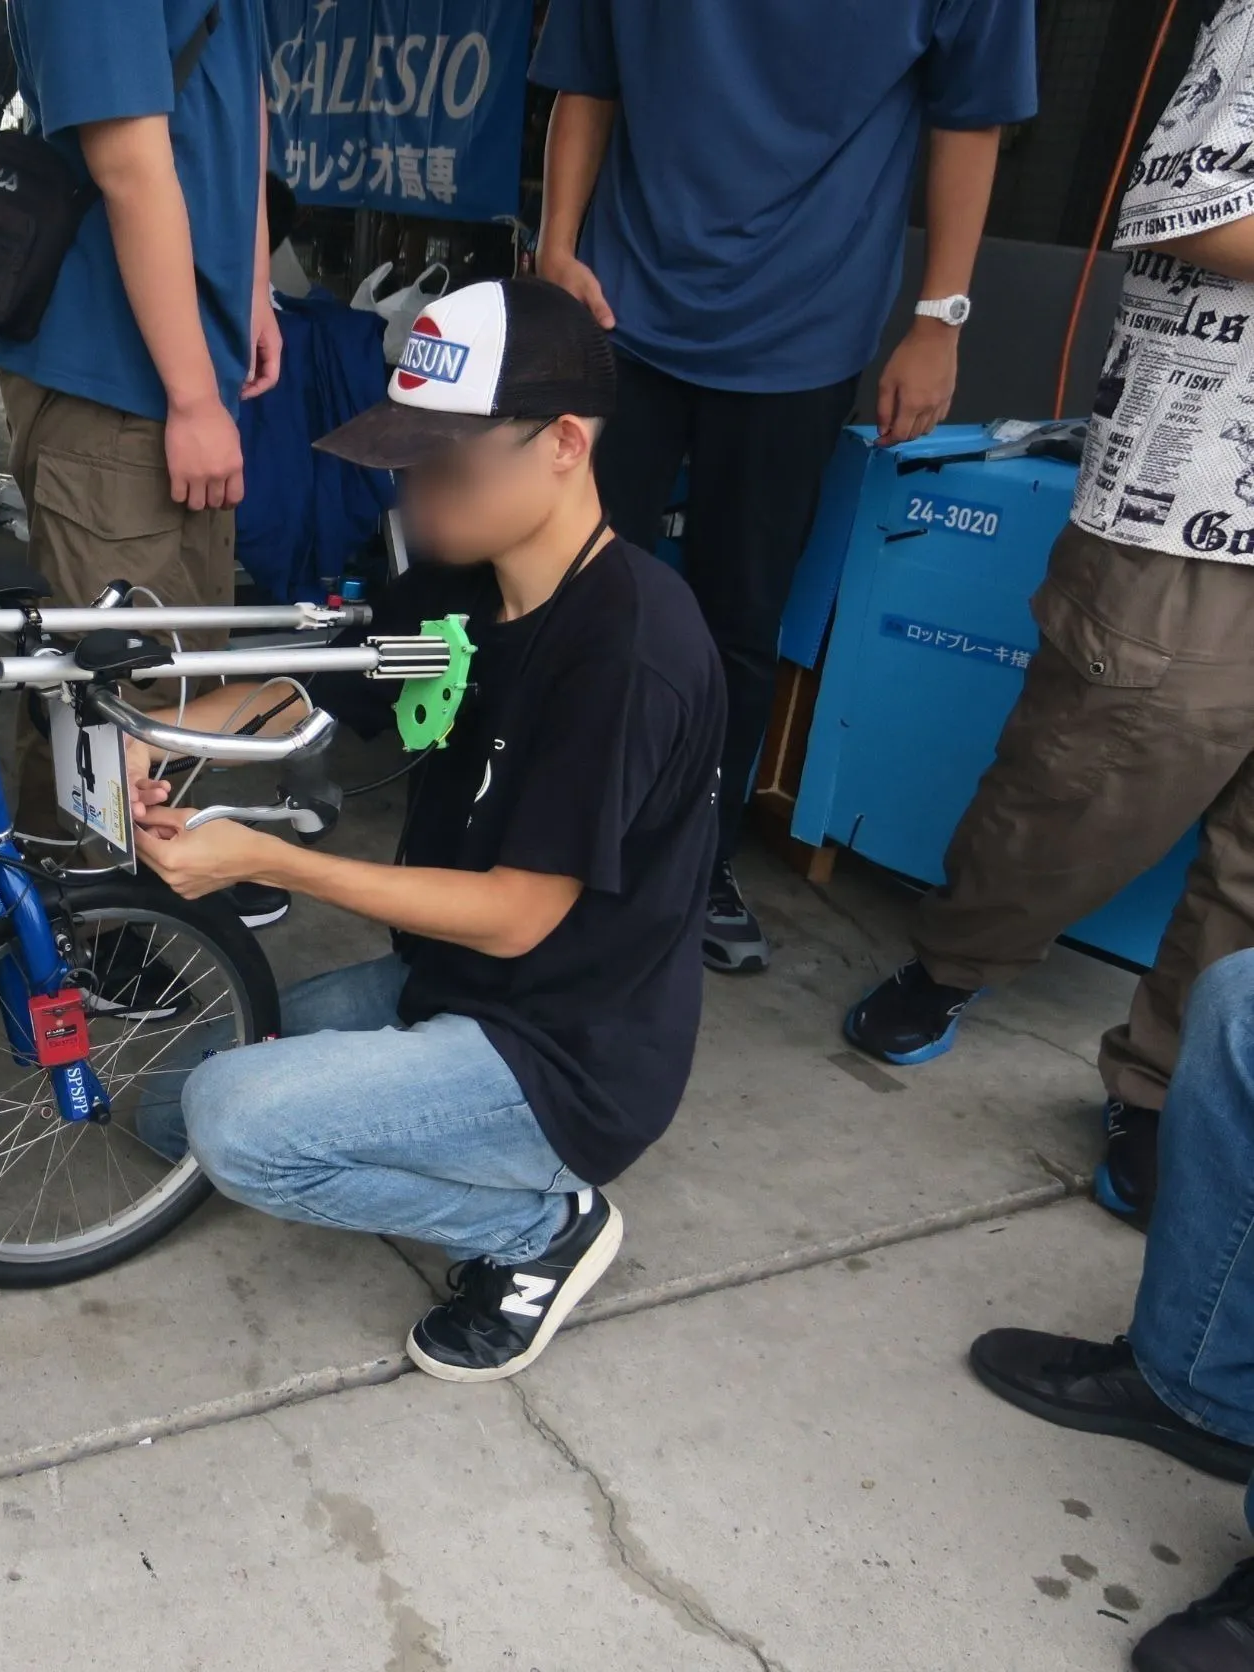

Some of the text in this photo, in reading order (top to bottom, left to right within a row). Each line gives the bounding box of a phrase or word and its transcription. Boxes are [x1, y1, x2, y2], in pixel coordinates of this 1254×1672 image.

[267, 28, 491, 120] SALESIO
[284, 138, 458, 204] サレジオ高専
[1187, 196, 1243, 226] WHAT
[1167, 370, 1186, 385] IT
[907, 497, 998, 536] 24-3020
[67, 1067, 89, 1114] SPSFP
